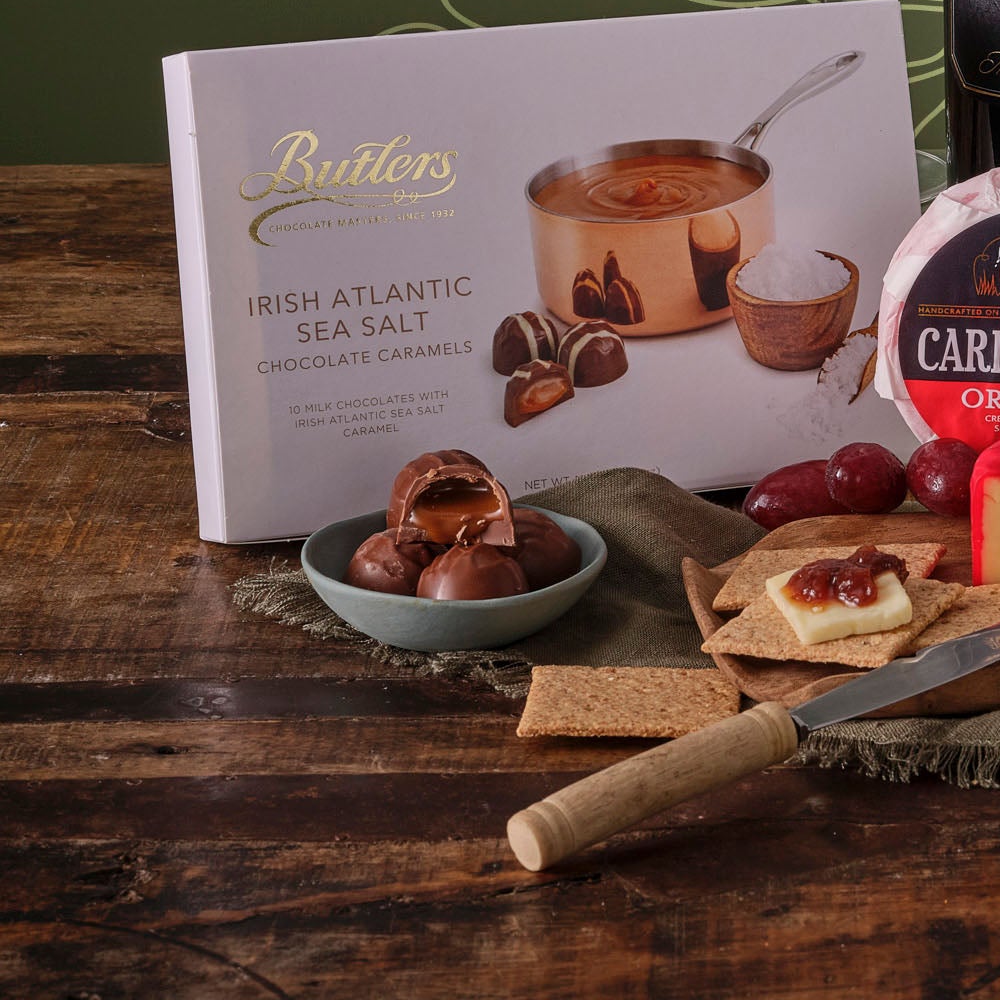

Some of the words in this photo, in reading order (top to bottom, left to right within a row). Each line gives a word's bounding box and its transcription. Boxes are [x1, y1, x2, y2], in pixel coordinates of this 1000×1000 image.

[239, 129, 458, 200] Butlers
[269, 219, 333, 233] CHOCOLATE
[431, 209, 455, 219] 1932
[248, 291, 319, 317] IRISH
[331, 276, 473, 309] ATLANTIC
[918, 306, 983, 316] HANDCRAFTED
[297, 319, 351, 343] SEA
[362, 311, 429, 336] SALT
[257, 351, 370, 374] CHOCOLATE
[378, 340, 473, 362] CARAMELS
[288, 405, 301, 415] 10
[305, 402, 333, 413] MILK
[336, 393, 414, 410] CHOCOLATES
[418, 390, 449, 401] WITH
[294, 417, 325, 429] IRISH
[329, 410, 386, 425] ATLANTIC
[390, 408, 413, 419] SEA
[417, 404, 445, 416] SALT
[343, 423, 400, 438] CARAMEL
[524, 478, 547, 491] NET
